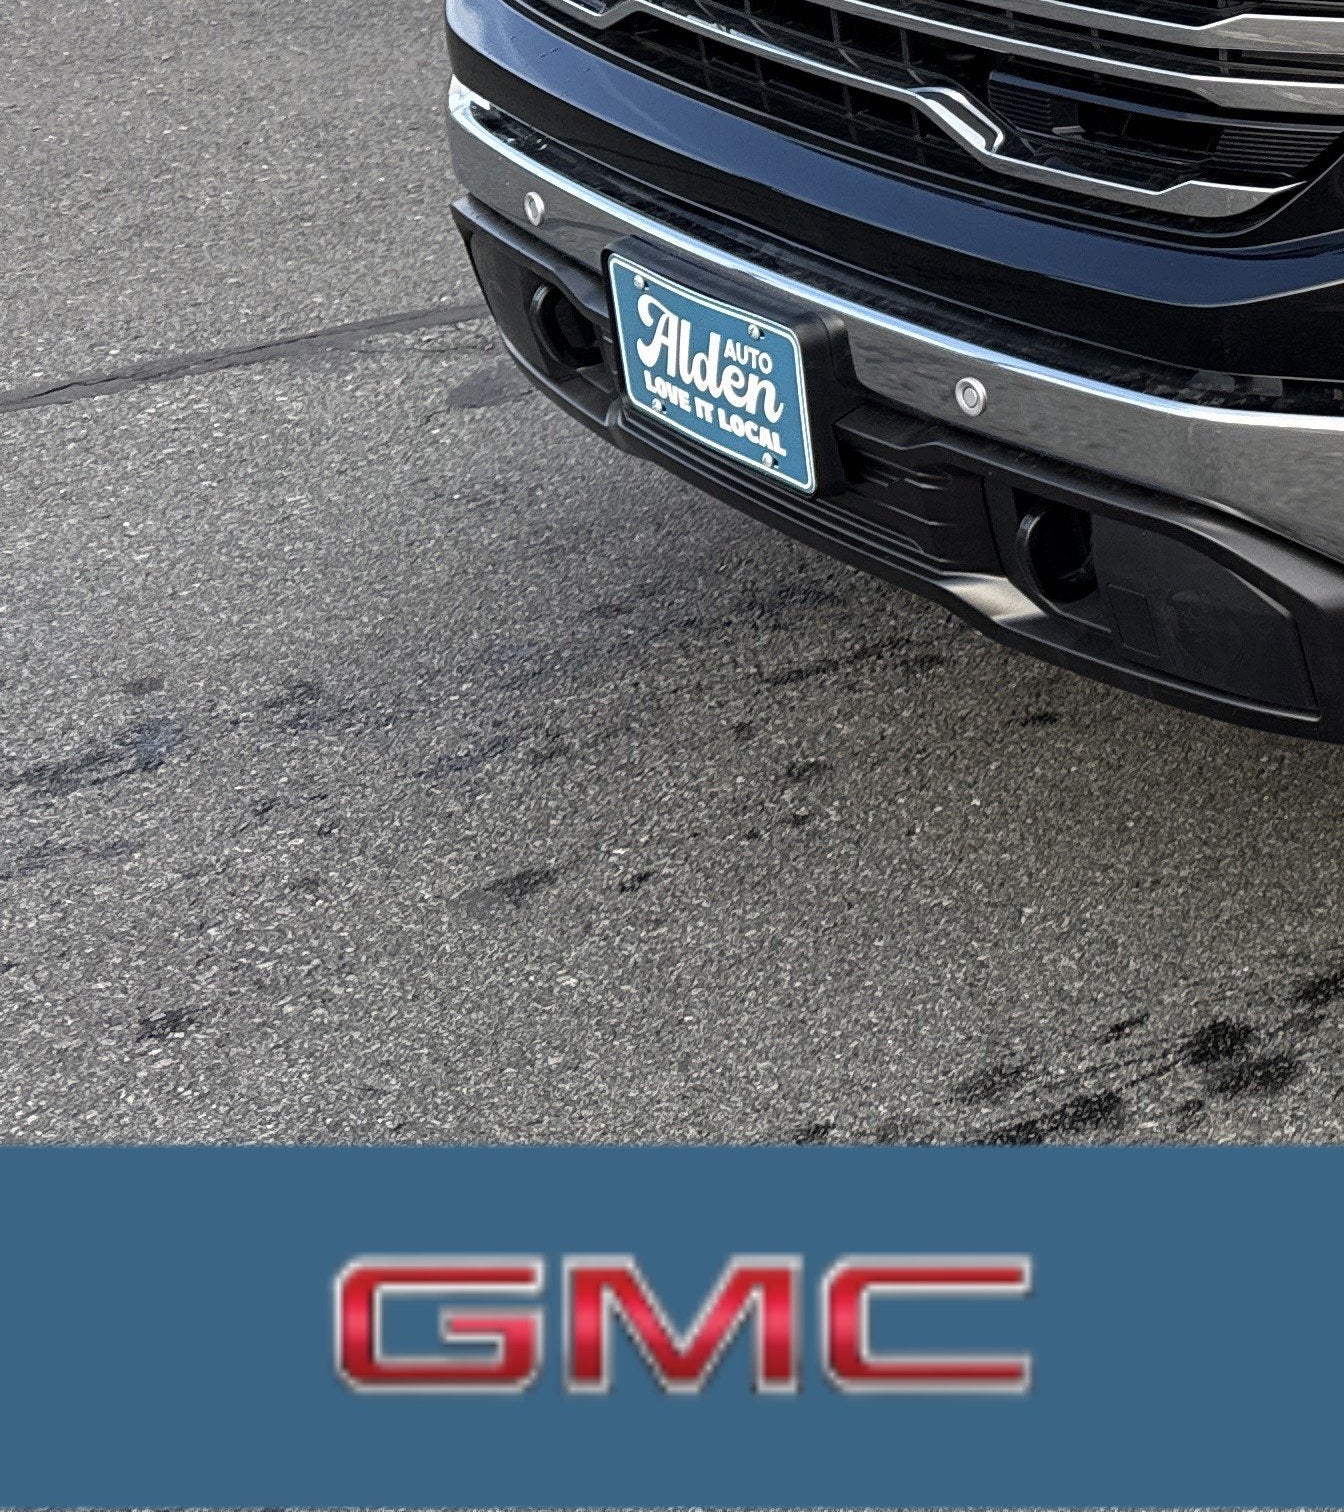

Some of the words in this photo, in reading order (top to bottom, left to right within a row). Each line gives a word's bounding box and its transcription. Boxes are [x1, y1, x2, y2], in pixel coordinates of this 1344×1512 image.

[637, 294, 784, 423] Alden
[724, 338, 773, 374] AUTO
[643, 369, 692, 413] LOVE
[694, 397, 714, 424] IT
[717, 407, 787, 457] LOCAL
